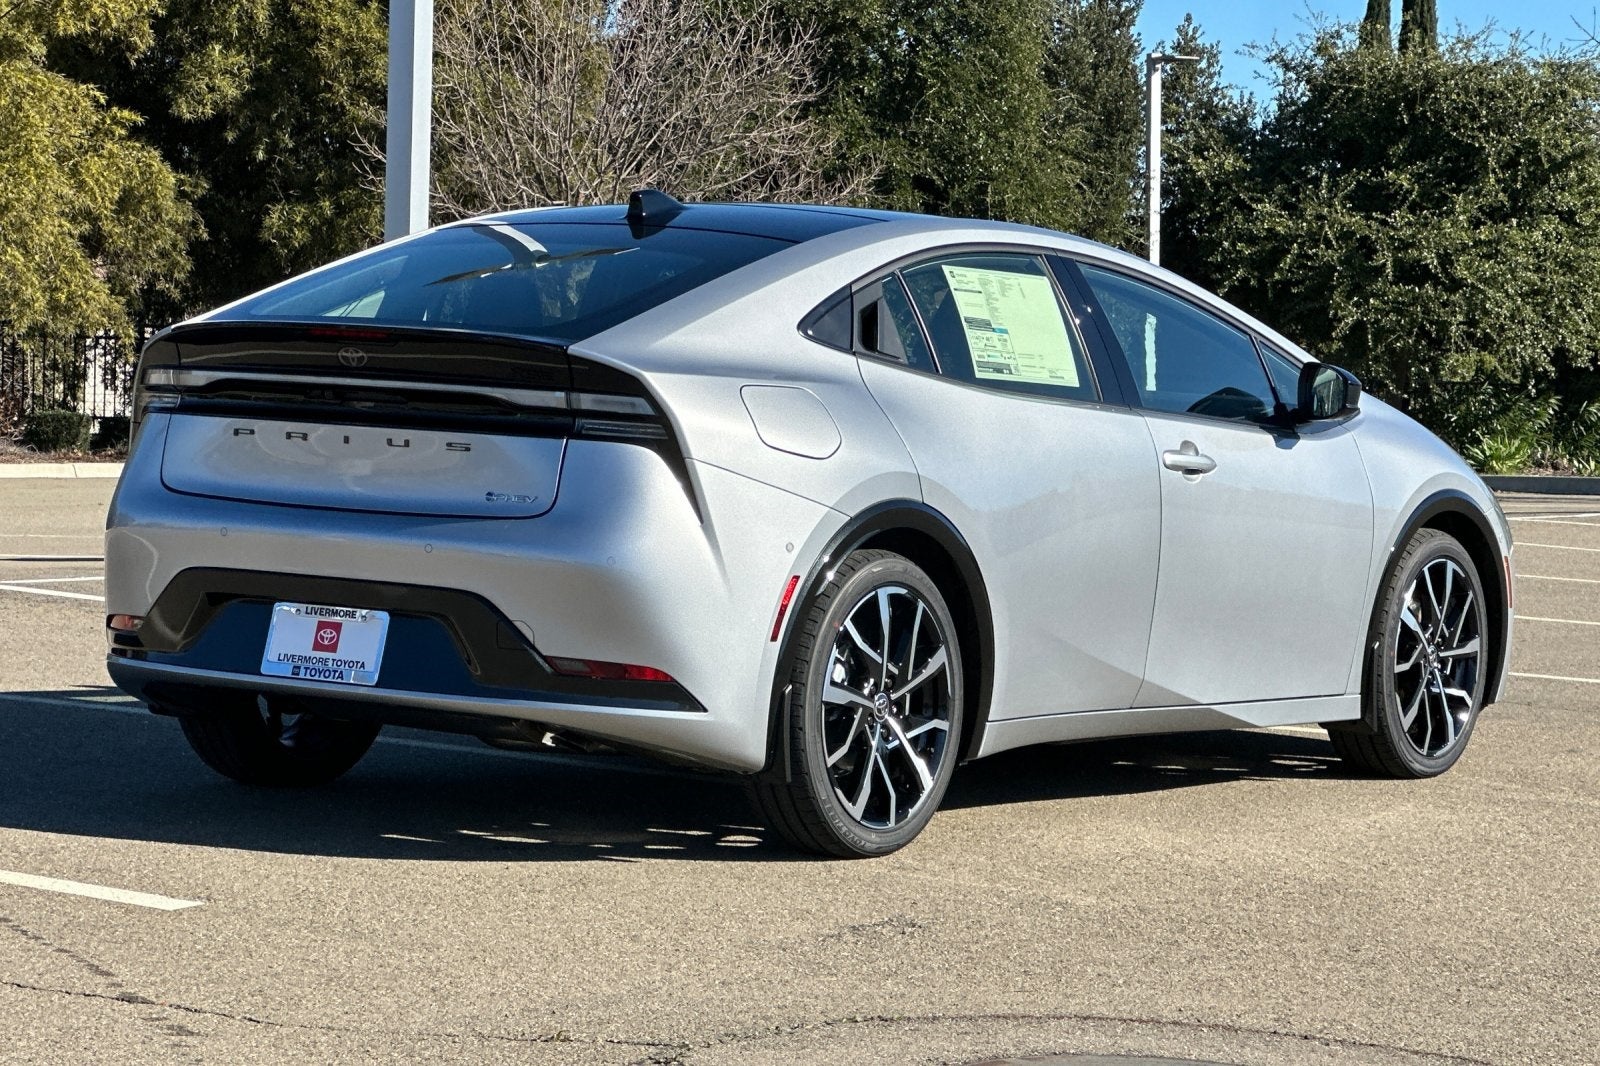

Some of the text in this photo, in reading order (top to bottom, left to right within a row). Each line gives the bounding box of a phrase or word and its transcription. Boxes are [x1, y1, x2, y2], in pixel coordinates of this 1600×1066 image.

[233, 428, 472, 452] PRIUS
[494, 493, 538, 503] PHEV
[305, 606, 357, 619] LIVERMORE
[277, 653, 365, 670] LIVERMORE TOYOTA
[303, 667, 344, 681] TOYOTA
